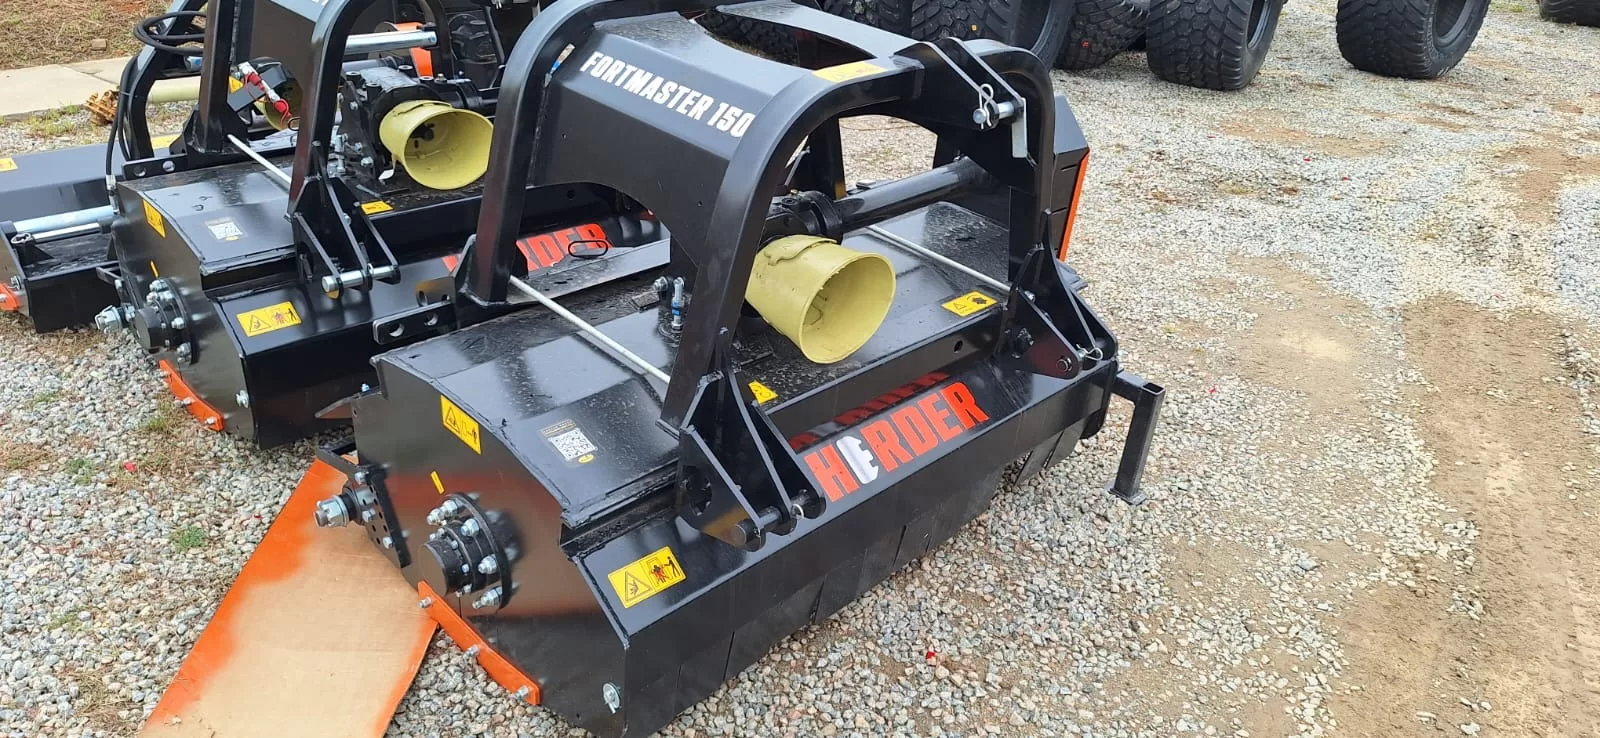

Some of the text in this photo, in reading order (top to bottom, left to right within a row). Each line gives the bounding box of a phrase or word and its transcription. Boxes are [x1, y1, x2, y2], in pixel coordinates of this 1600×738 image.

[579, 51, 756, 138] FORTMASTER 150
[804, 382, 990, 503] HERDER
